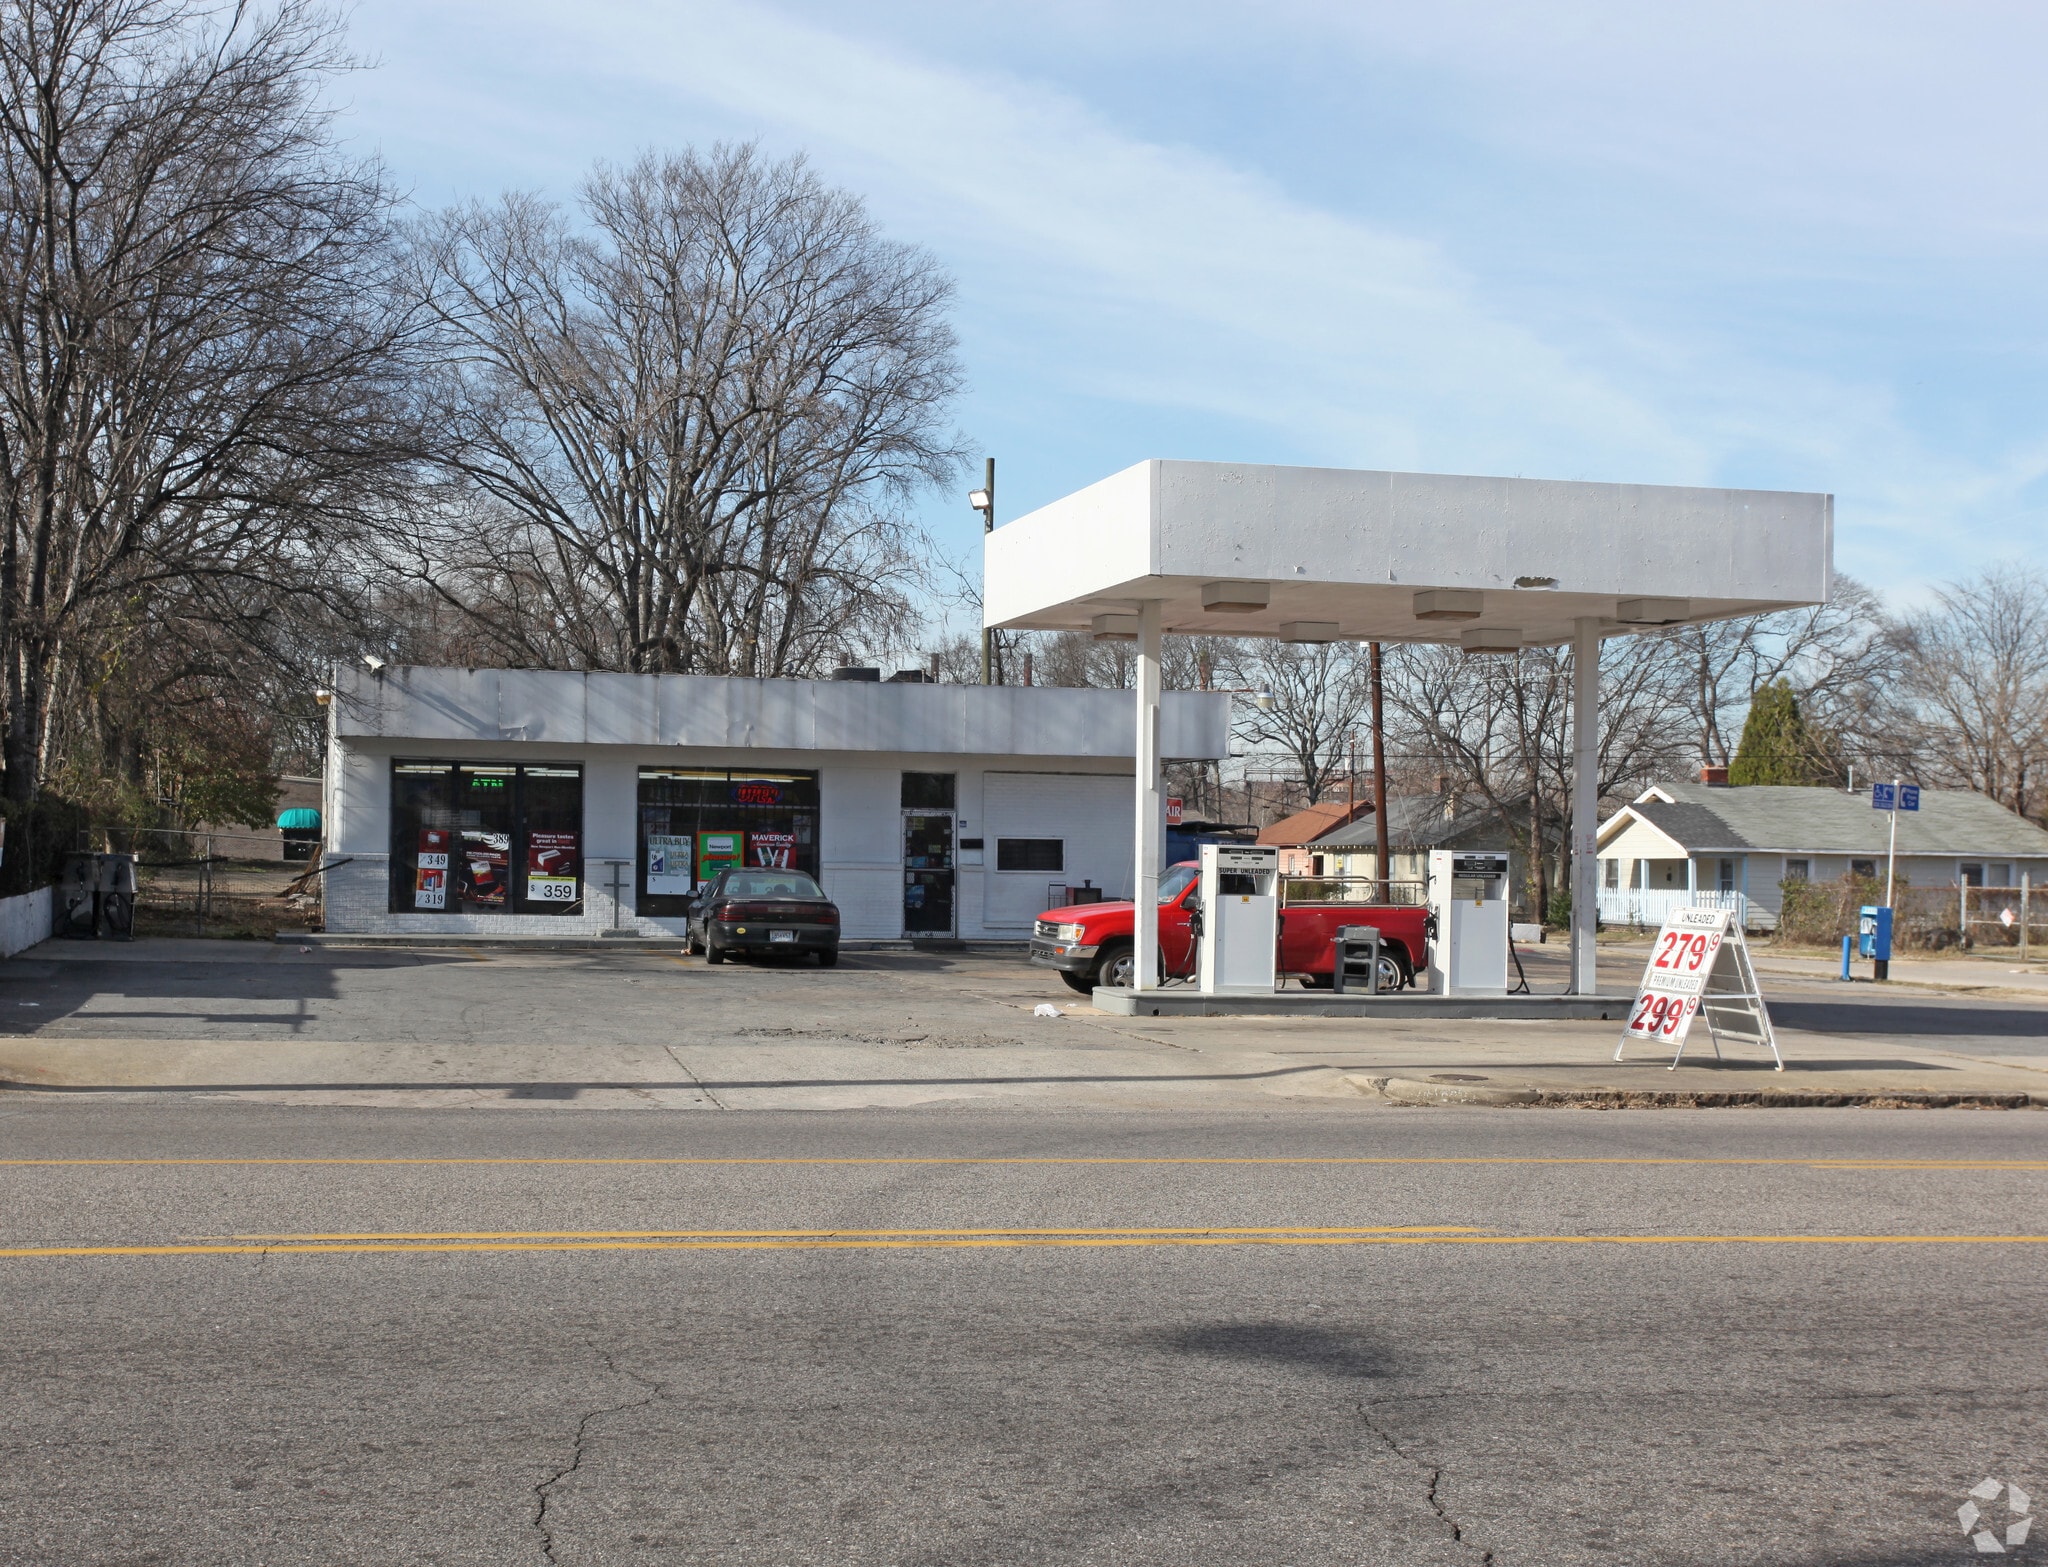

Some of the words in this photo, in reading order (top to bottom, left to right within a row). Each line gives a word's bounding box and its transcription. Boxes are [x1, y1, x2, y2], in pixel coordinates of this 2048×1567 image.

[472, 778, 504, 787] ATM
[737, 784, 779, 804] OPEN
[1166, 806, 1180, 817] AIR
[493, 833, 509, 844] 389
[649, 837, 673, 845] ULTRA
[674, 837, 690, 846] BUY
[751, 834, 794, 842] MAVERICK
[1681, 914, 1716, 925] UNLEADED
[1655, 931, 1706, 970] 279
[1631, 993, 1684, 1035] 299
